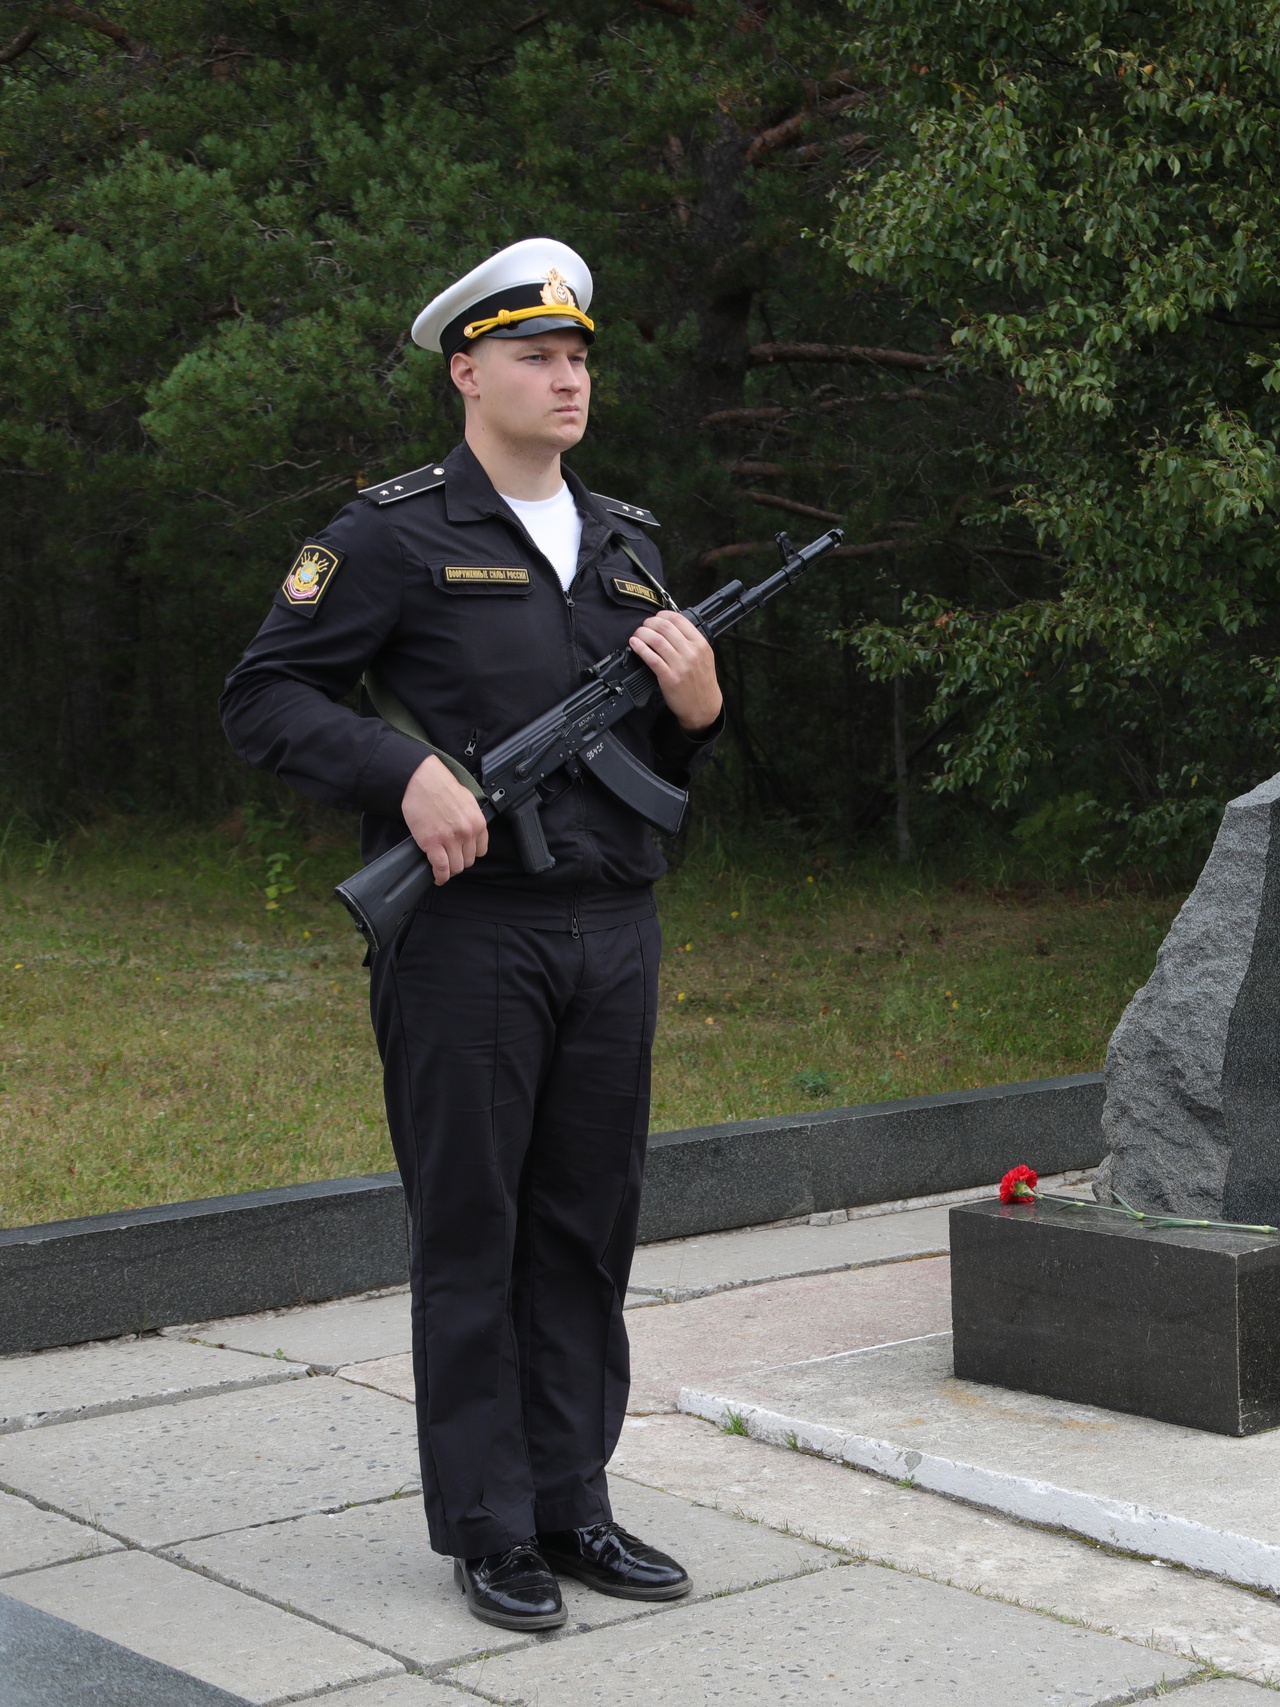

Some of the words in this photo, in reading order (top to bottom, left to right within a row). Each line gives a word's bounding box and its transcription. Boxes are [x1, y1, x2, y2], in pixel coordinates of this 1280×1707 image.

[448, 568, 488, 579] ВООРУЖЕННЫЕ
[489, 569, 505, 579] СИЛЫ
[507, 570, 527, 580] РОССИИ
